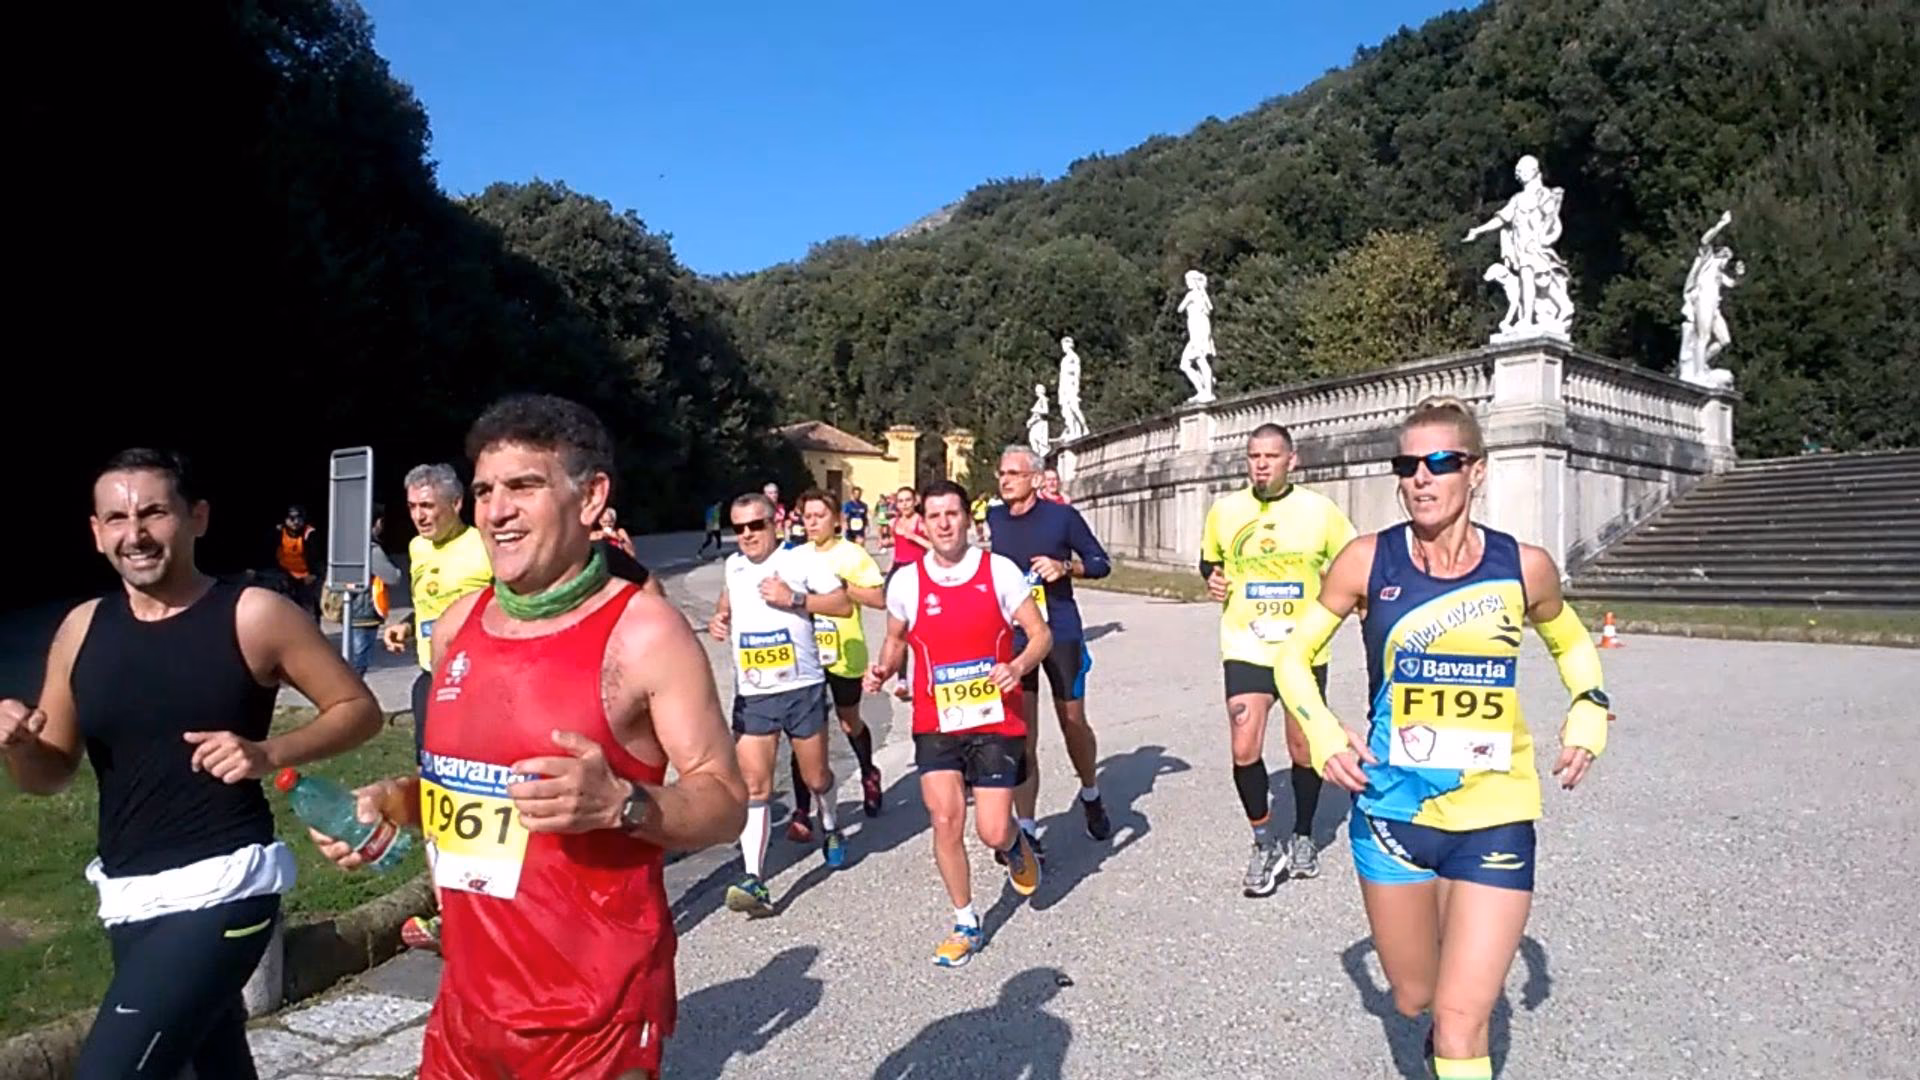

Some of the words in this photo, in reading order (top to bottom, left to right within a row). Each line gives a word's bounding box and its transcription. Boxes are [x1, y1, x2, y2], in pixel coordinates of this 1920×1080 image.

[1255, 601, 1294, 616] 990
[744, 647, 790, 665] 1658
[1422, 659, 1507, 679] Bavaria
[942, 680, 996, 703] 1966
[1403, 687, 1505, 720] F195
[426, 789, 513, 845] 1961
